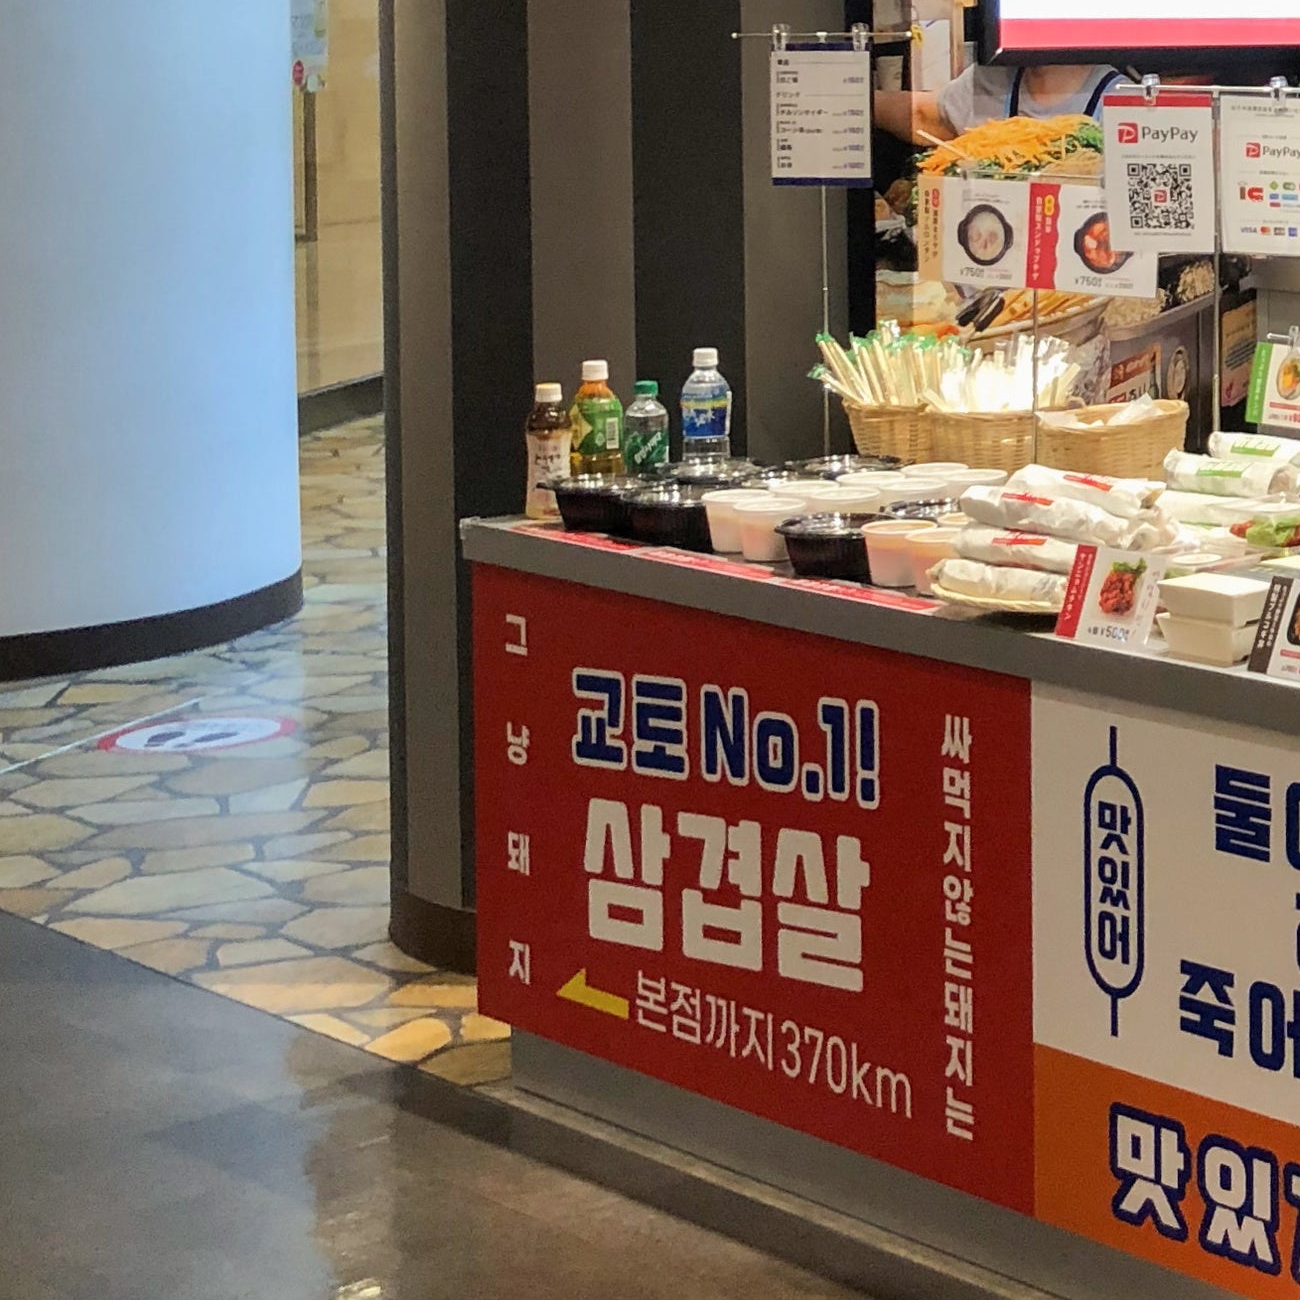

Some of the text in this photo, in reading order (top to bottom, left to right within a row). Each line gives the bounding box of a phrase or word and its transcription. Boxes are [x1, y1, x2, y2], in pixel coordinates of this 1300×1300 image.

[1141, 126, 1198, 143] PayPay
[572, 667, 881, 810] 교토 No.1!
[584, 797, 871, 993] 삼겹살
[1097, 799, 1131, 966] 맛있어
